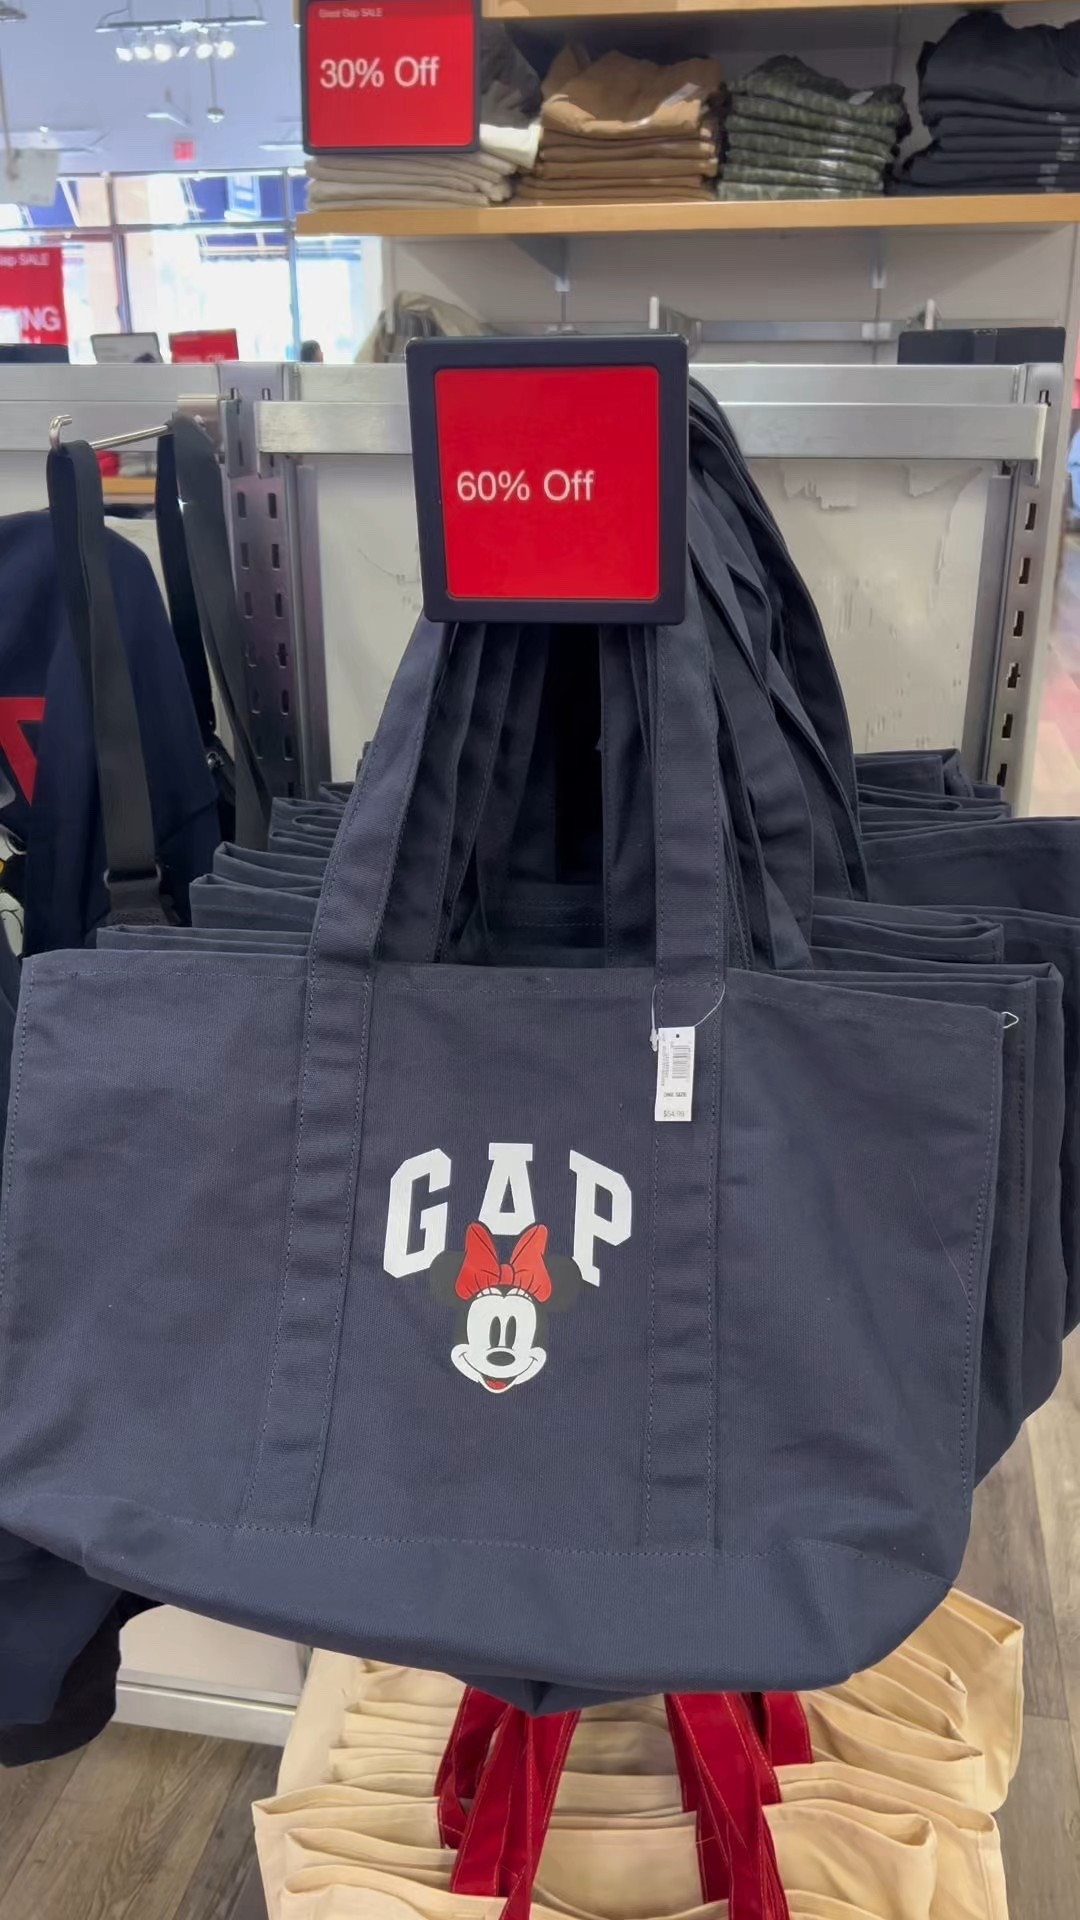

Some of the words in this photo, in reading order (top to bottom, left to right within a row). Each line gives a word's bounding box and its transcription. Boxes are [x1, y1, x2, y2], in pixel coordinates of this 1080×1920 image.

[361, 8, 383, 17] SALE
[320, 57, 385, 88] 30%
[394, 56, 440, 88] Off
[19, 252, 49, 267] SALE
[457, 470, 531, 502] 60%
[543, 469, 595, 501] Off
[383, 1142, 632, 1288] GAP
